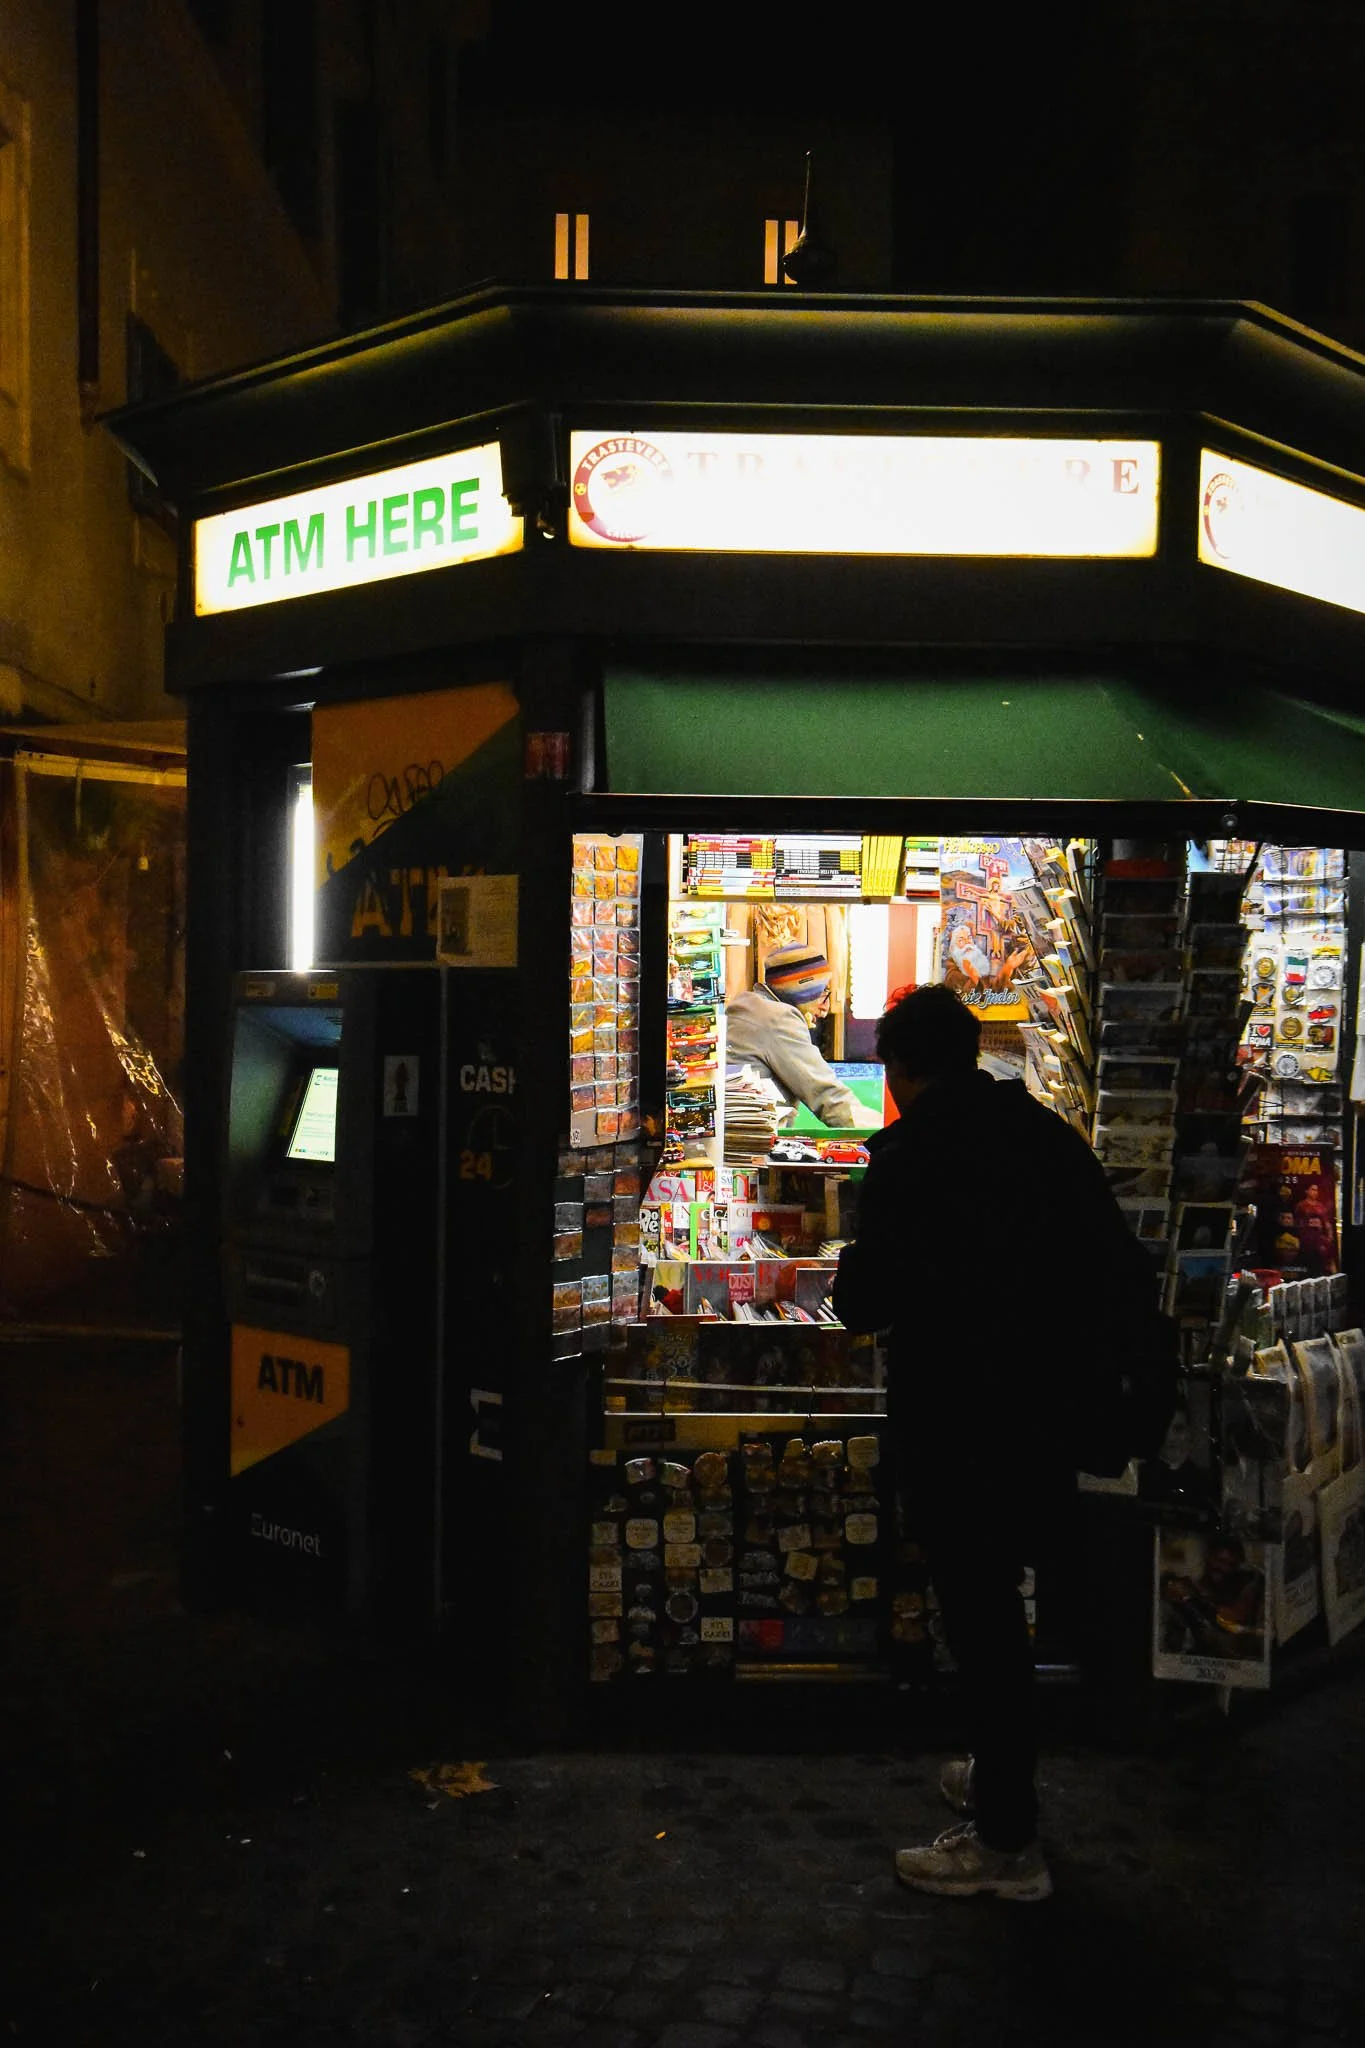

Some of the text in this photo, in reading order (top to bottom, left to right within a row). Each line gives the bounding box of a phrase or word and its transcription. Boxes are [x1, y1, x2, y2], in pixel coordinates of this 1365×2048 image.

[227, 477, 481, 588] ATM HERE
[459, 1149, 493, 1181] 24
[1280, 1155, 1322, 1176] OMA
[645, 1179, 690, 1203] ASA
[257, 1355, 323, 1403] ATM
[250, 1511, 321, 1558] Euronet
